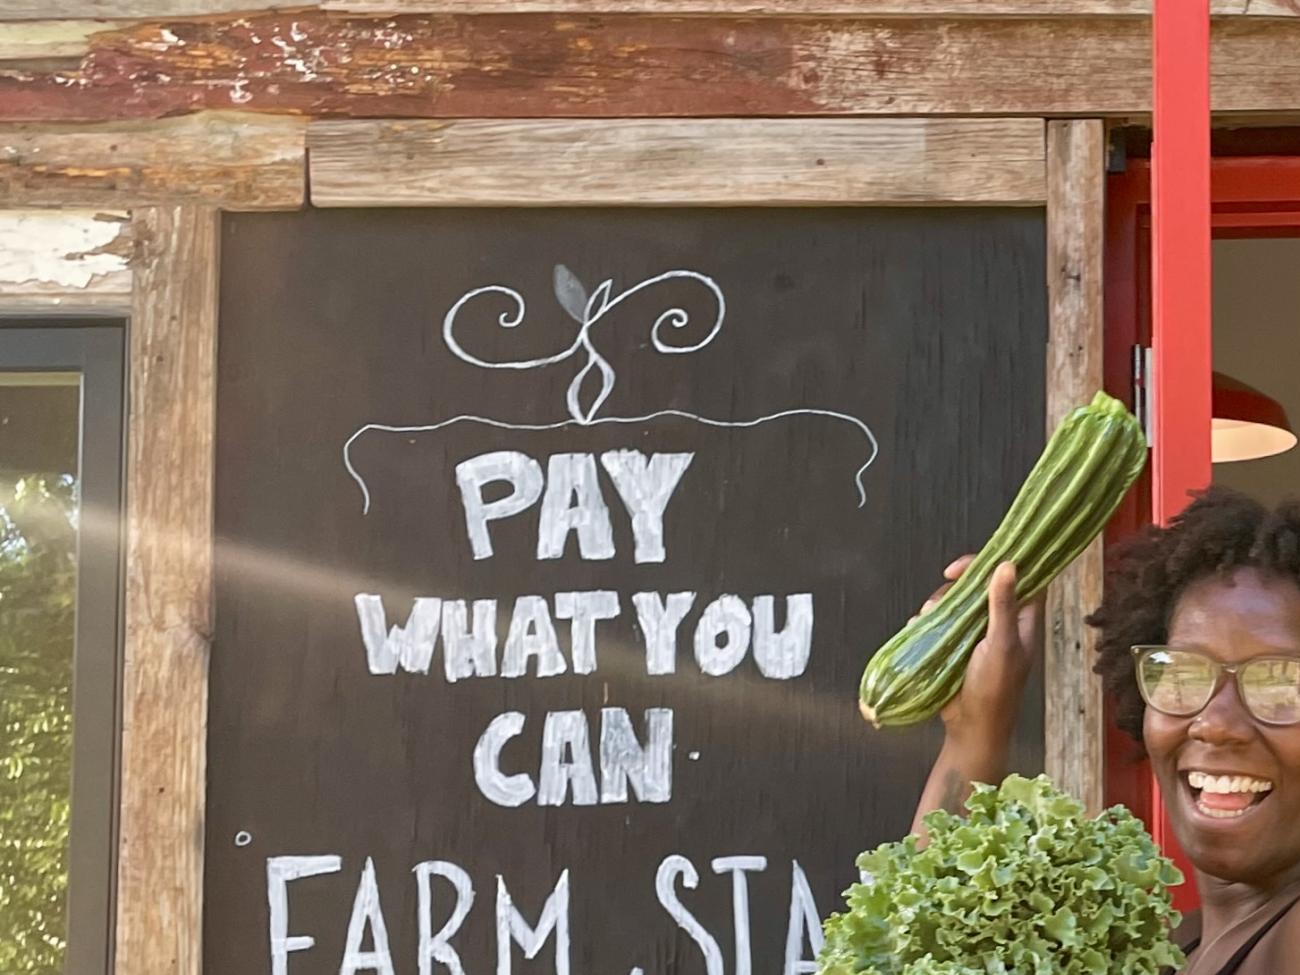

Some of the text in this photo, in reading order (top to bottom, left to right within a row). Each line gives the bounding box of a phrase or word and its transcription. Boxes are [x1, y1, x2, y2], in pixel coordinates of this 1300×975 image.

[455, 449, 696, 564] PAY
[354, 590, 814, 682] WHAT YOU
[472, 706, 674, 807] CAN
